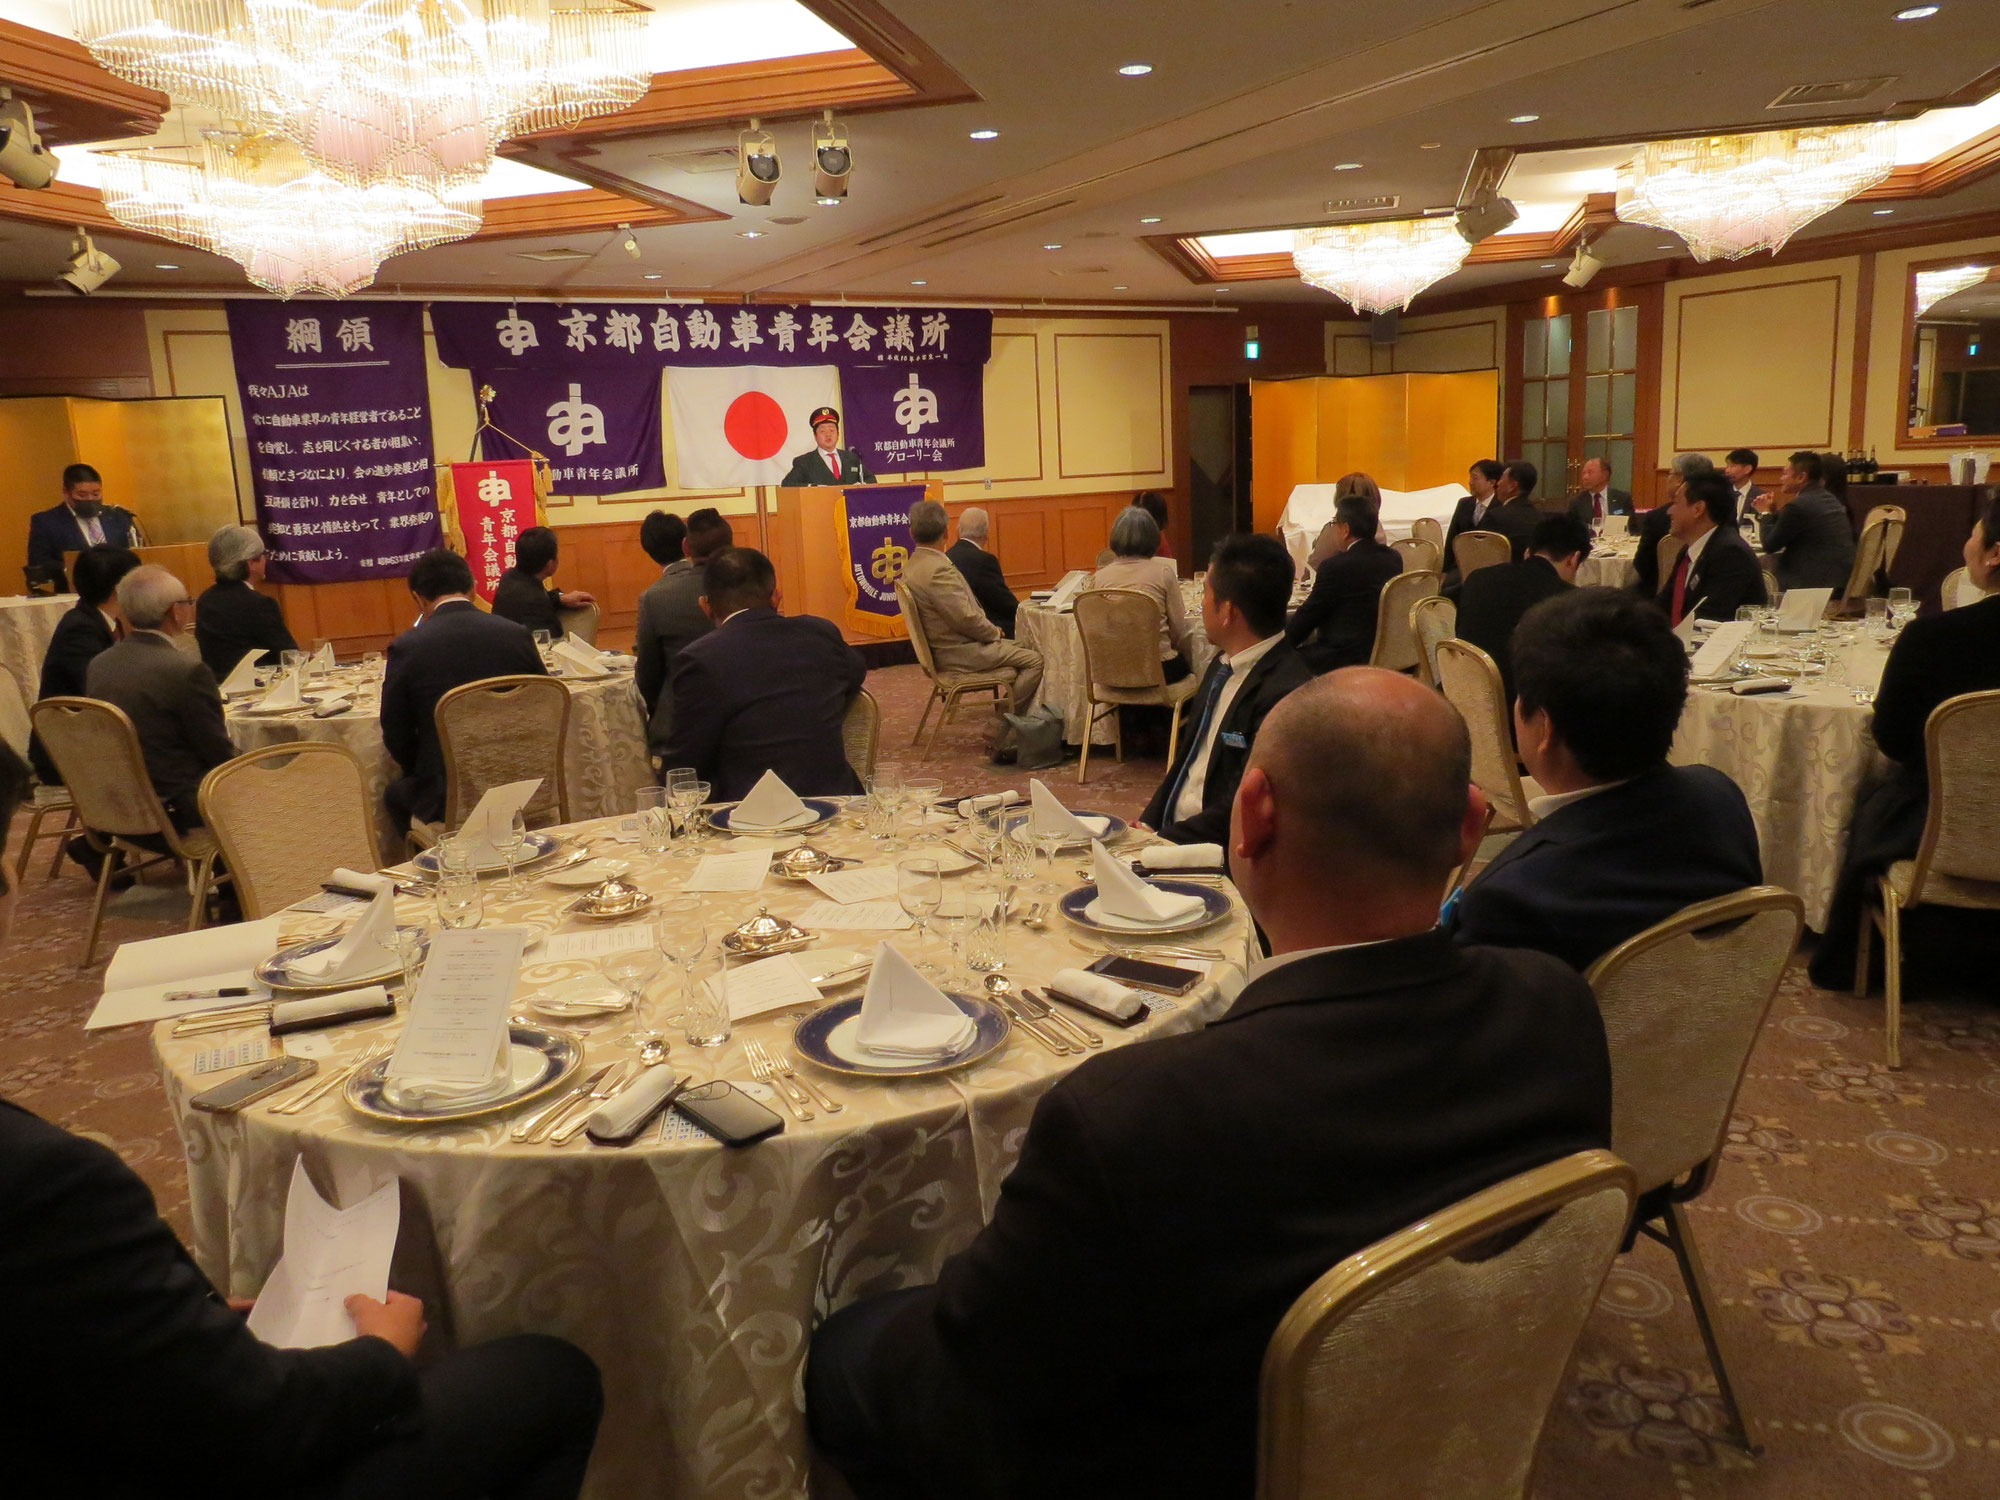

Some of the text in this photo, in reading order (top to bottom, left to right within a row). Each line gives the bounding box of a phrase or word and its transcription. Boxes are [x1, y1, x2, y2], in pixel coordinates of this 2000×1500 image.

[284, 316, 374, 353] 綱領
[558, 308, 950, 354] 京都自動車青年会議所
[874, 438, 955, 452] 京都自動車青年会議所
[887, 449, 943, 464] グローリー会
[499, 507, 518, 569] 京都自動
[849, 512, 911, 528] 京都自動車青年会
[480, 516, 502, 591] 青年会議所
[854, 563, 898, 601] AUTOMOBILE JUNIO
